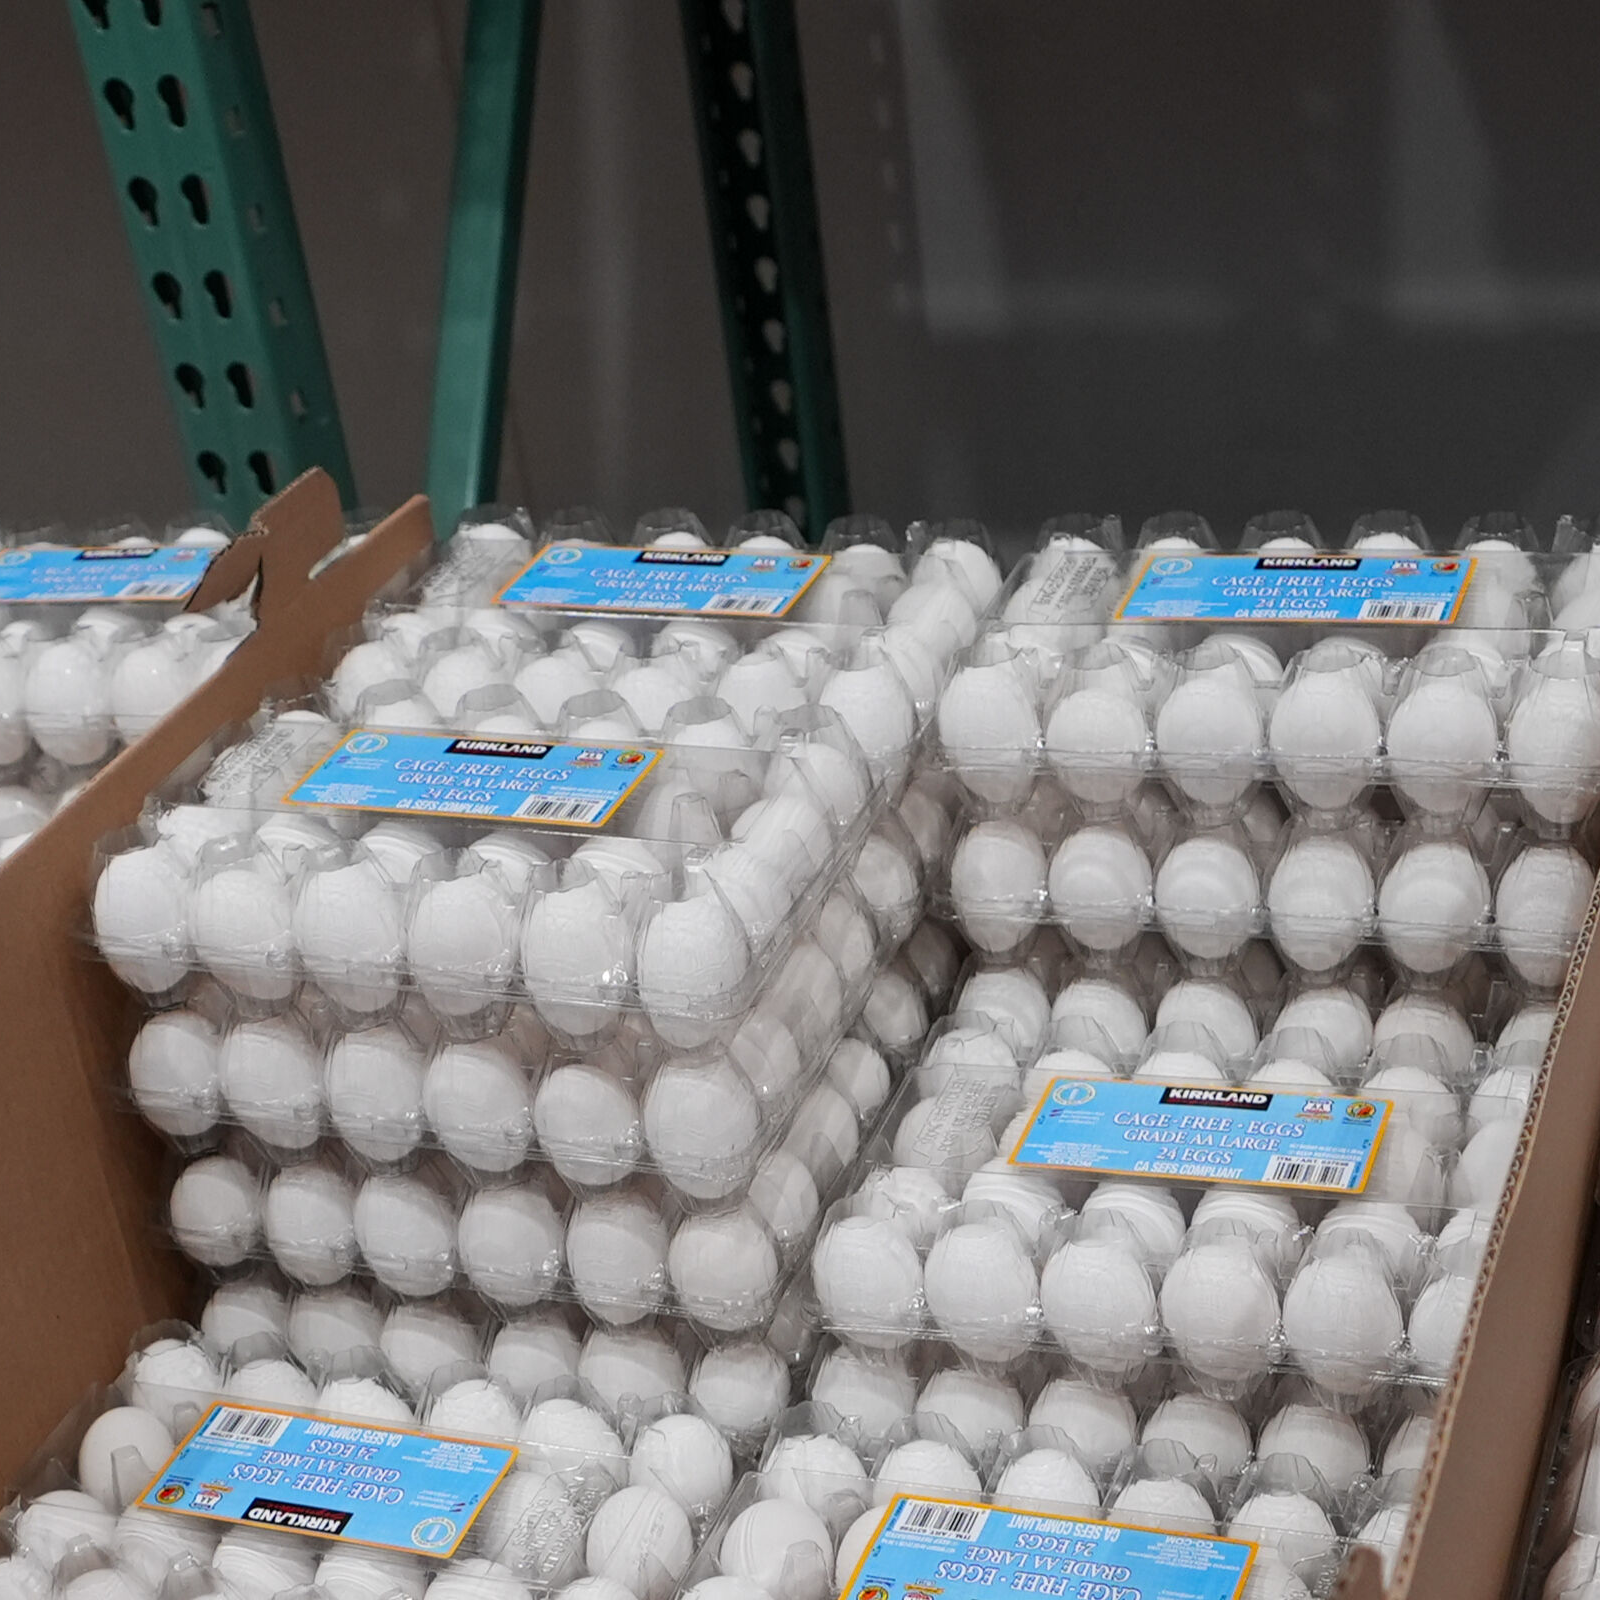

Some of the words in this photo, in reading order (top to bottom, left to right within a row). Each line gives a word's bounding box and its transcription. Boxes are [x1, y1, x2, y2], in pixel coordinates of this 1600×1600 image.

[1168, 1087, 1268, 1104] KIRKLAND
[1122, 1127, 1189, 1145] GRADE
[1217, 1135, 1282, 1152] LARGE
[1245, 1120, 1307, 1139] EGGS
[257, 1449, 317, 1471] LARGE
[315, 1457, 343, 1474] AA
[226, 1463, 286, 1487] EGGS
[337, 1462, 401, 1484] GRADE
[247, 1507, 341, 1532] KIRKLAND
[1005, 1512, 1075, 1536] COMPLIANT
[1071, 1521, 1105, 1540] SEFS
[1013, 1532, 1072, 1555] EGGS
[1102, 1525, 1123, 1543] CA
[962, 1545, 1030, 1569] LARGE
[1071, 1540, 1098, 1558] 24
[932, 1561, 998, 1588] EGGS
[1032, 1554, 1061, 1573] AA
[1058, 1559, 1131, 1584] GRADE
